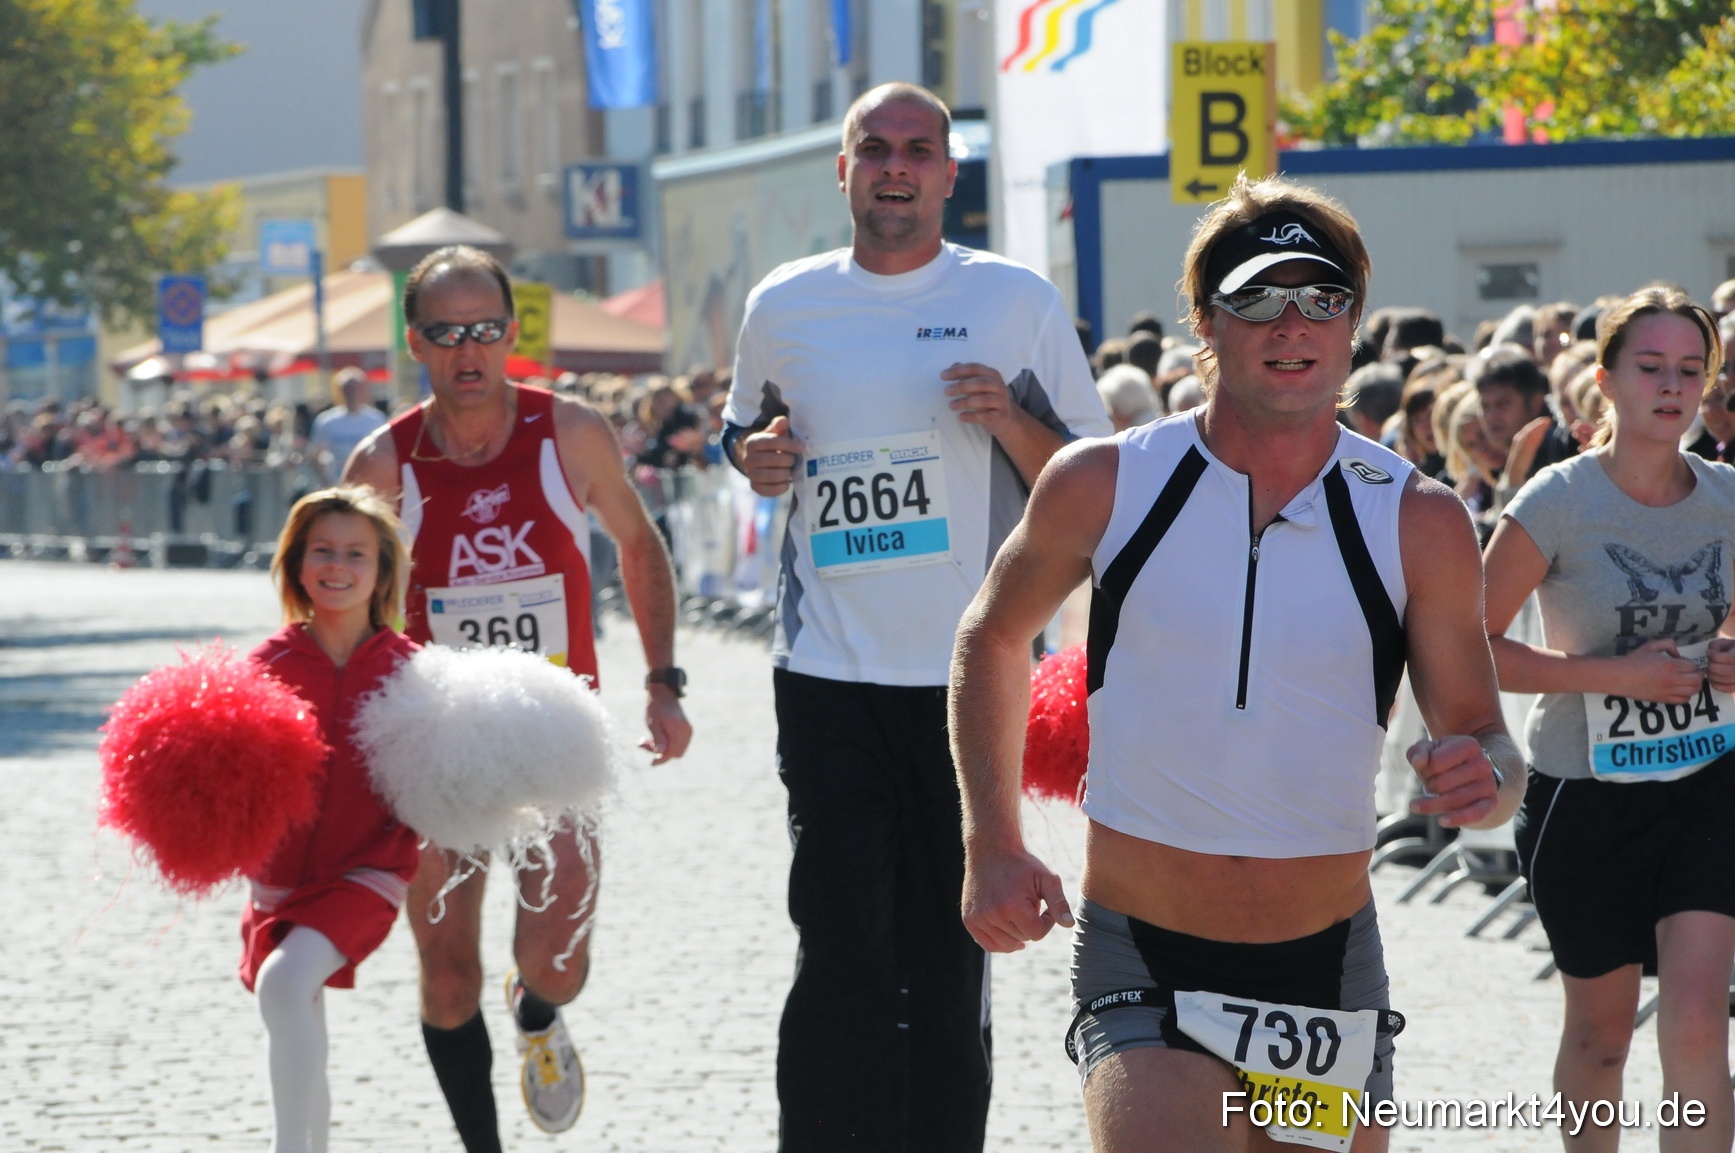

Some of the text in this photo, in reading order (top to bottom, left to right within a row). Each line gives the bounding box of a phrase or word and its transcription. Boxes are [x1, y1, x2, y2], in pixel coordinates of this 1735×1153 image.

[1184, 48, 1264, 76] Block
[1200, 92, 1248, 166] B
[818, 450, 875, 468] PFLEIDERER
[817, 468, 930, 528] 2664
[449, 520, 544, 580] ASK
[845, 528, 905, 556] Ivica
[459, 613, 539, 653] 369
[1614, 604, 1732, 636] FLY
[1611, 733, 1726, 768] Christine
[1222, 1002, 1342, 1077] 730
[1236, 1066, 1330, 1118] hristo-
